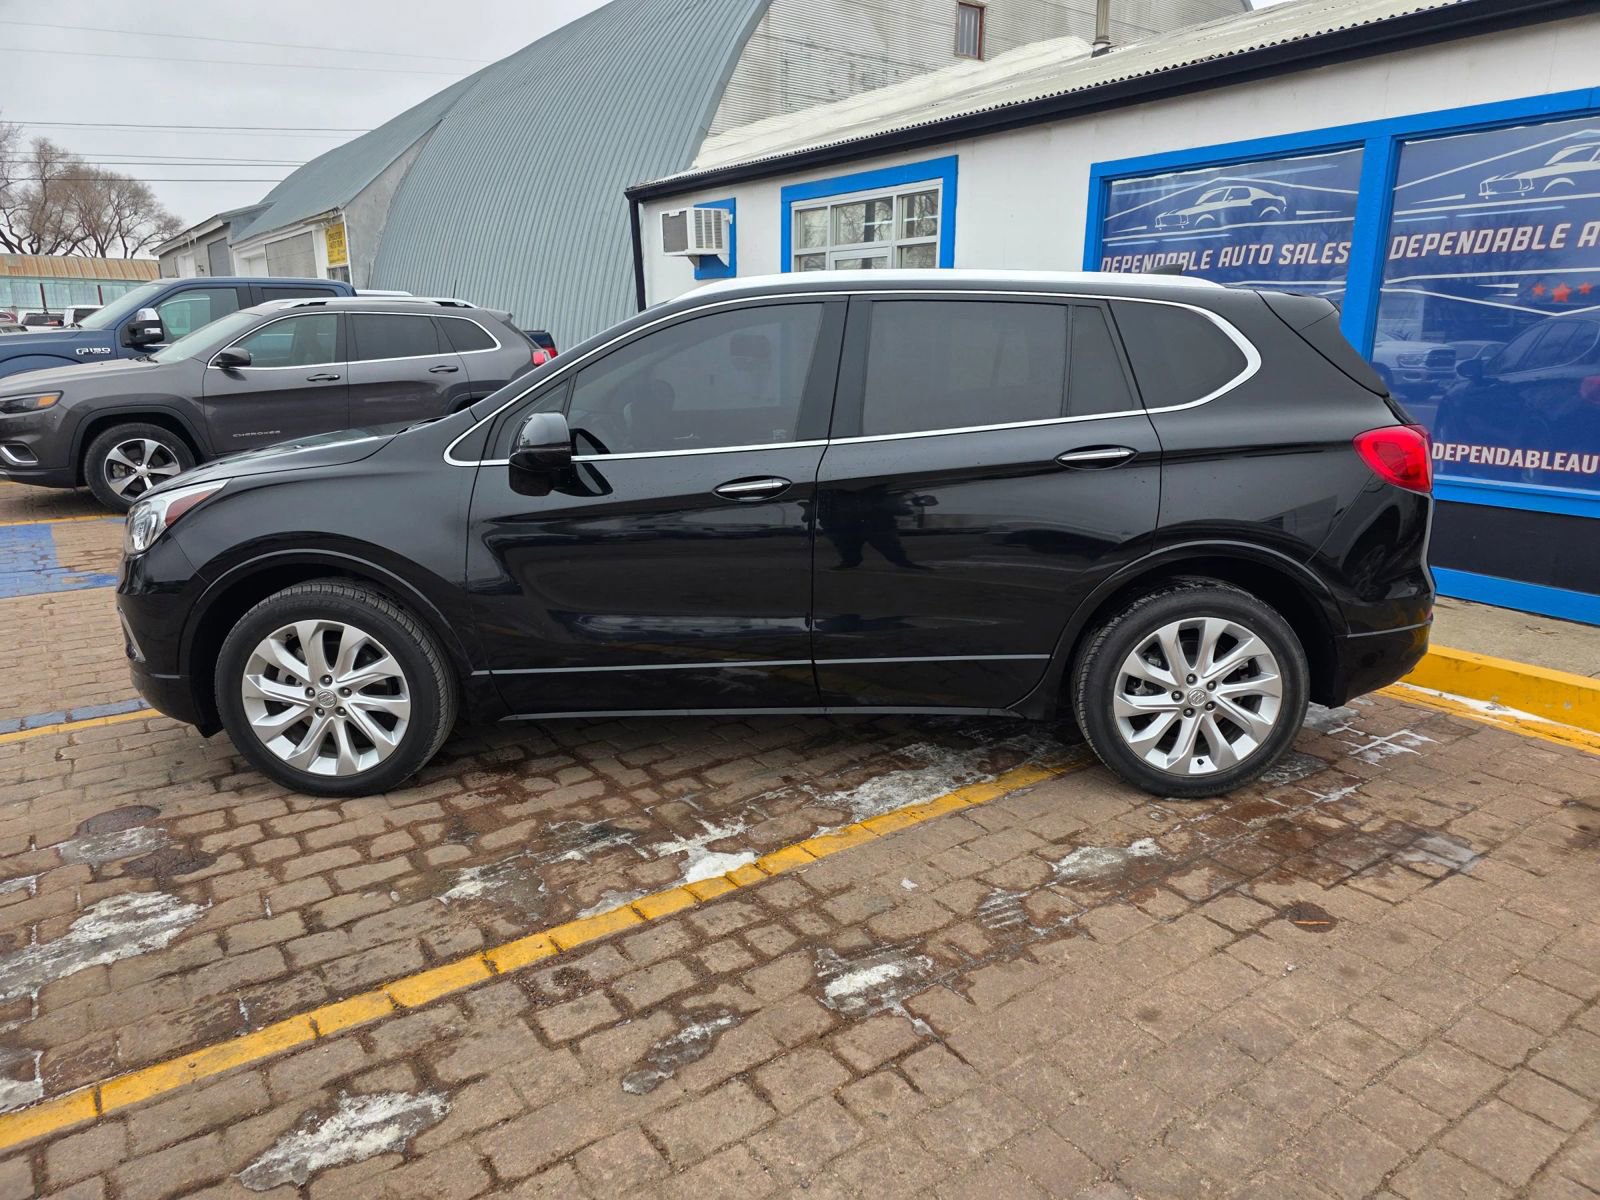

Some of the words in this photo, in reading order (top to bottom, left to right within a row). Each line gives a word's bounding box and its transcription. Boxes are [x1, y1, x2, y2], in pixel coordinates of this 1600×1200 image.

[1217, 244, 1274, 268] AUTO
[1278, 241, 1352, 265] SALES
[1388, 222, 1572, 260] DEPENDABLE
[1431, 441, 1600, 474] DEPENDABLEAU
